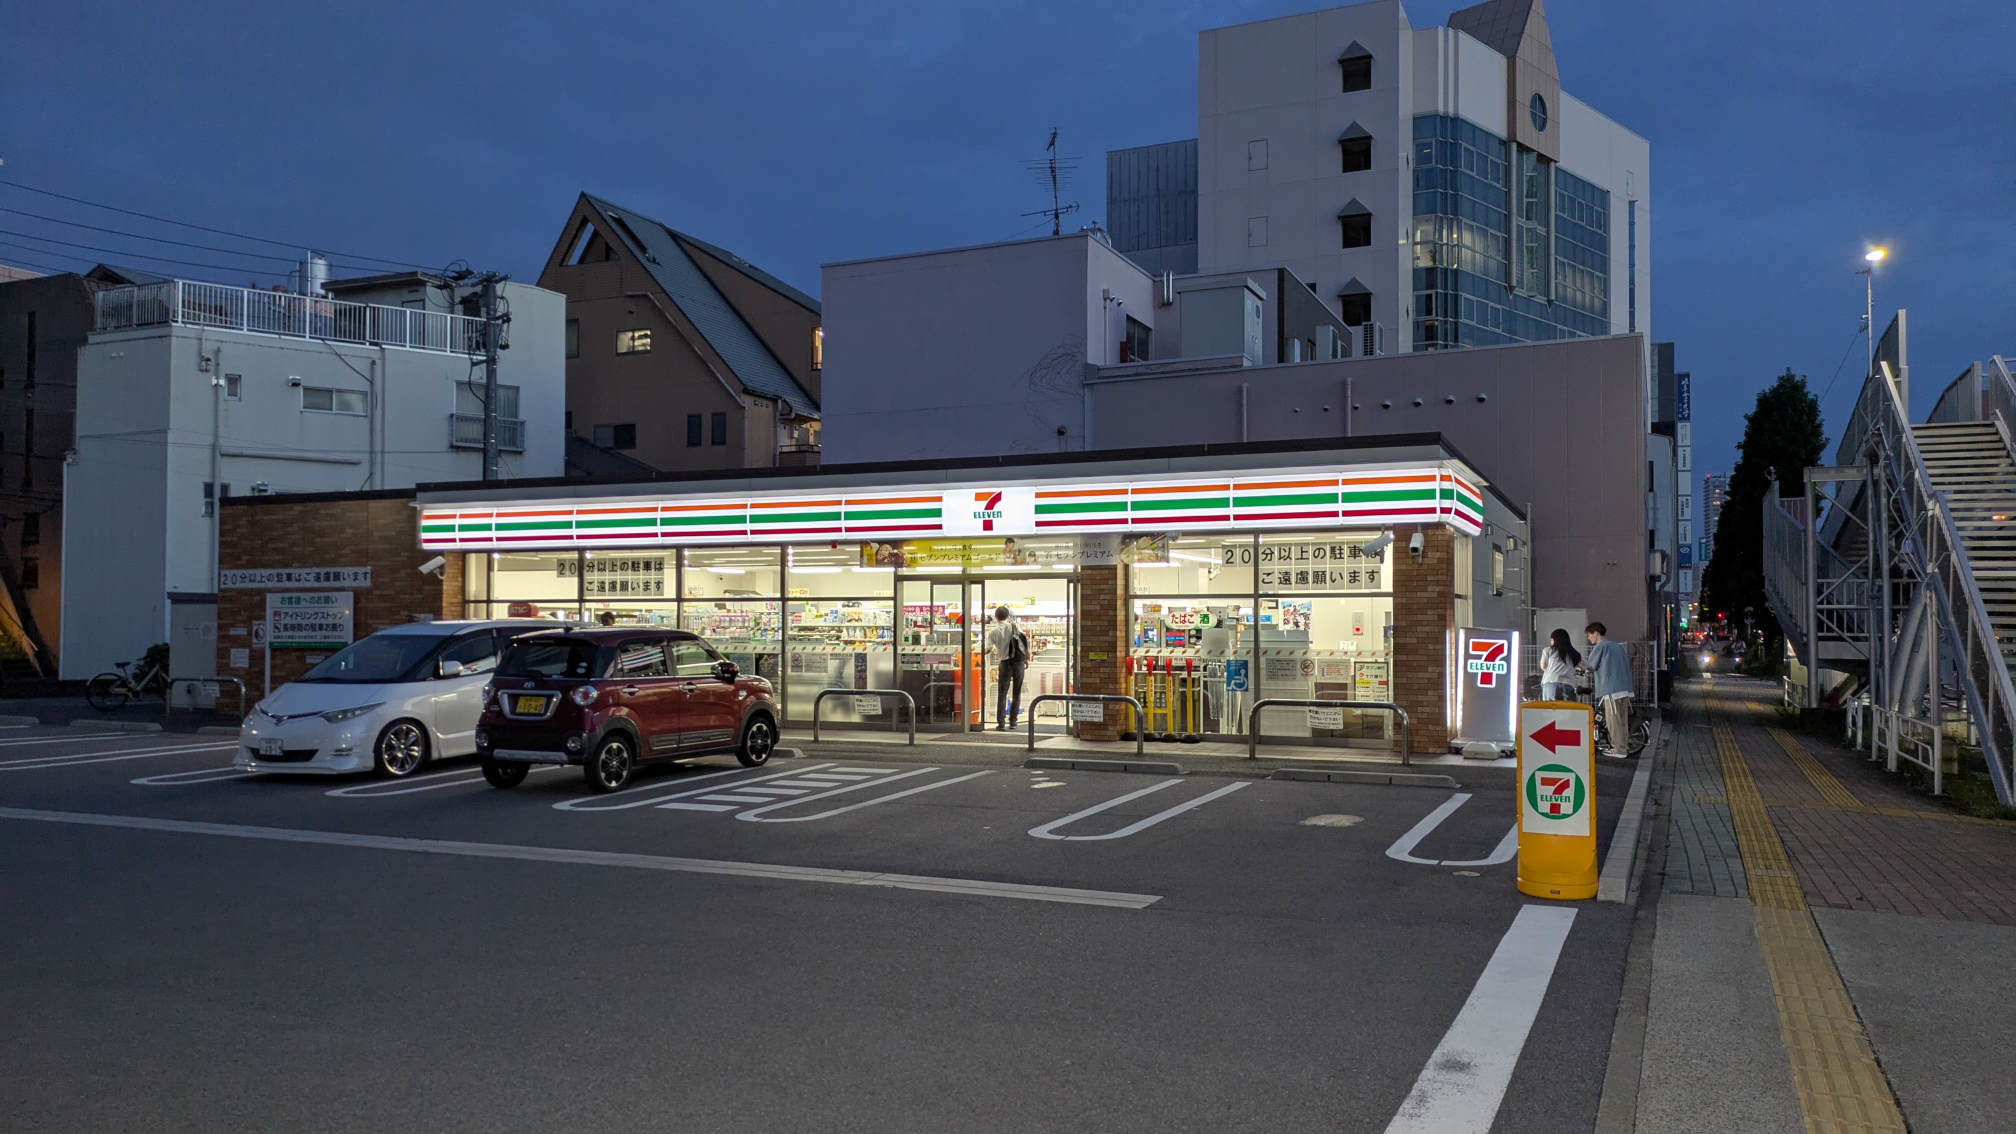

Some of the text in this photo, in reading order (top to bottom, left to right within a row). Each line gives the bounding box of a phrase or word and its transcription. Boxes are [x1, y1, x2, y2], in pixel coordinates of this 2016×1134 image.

[1261, 570, 1380, 585] ご遠慮願います
[586, 580, 664, 592] ご遠慮願います
[1171, 613, 1210, 625] たばこ 酒
